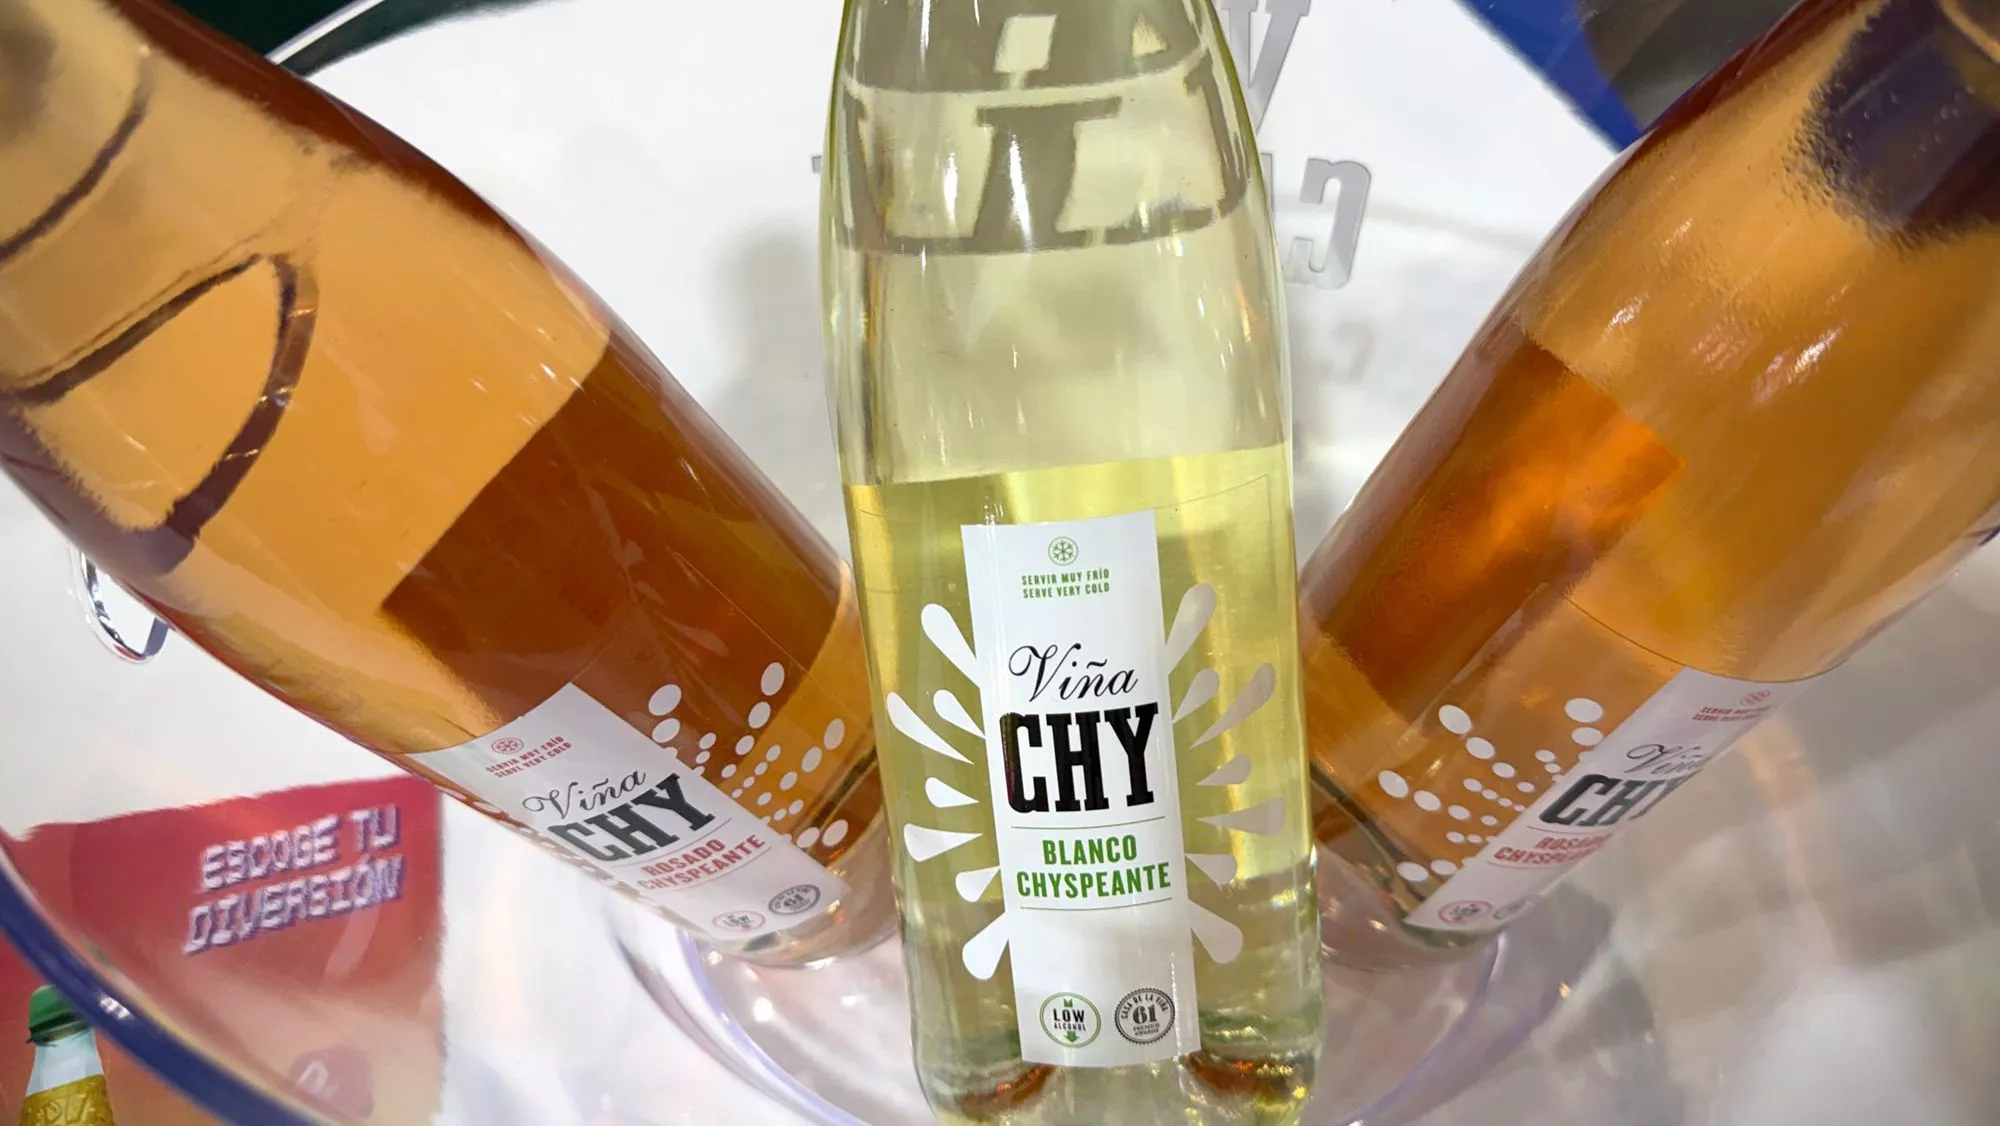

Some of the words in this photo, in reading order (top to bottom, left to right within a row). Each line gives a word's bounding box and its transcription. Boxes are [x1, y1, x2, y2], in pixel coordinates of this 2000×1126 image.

[1022, 574, 1057, 586] SERVIR
[1061, 571, 1082, 583] MUY
[1087, 567, 1110, 581] FRÍO
[1023, 587, 1053, 599] SERVE
[1056, 585, 1081, 597] VERY
[1085, 582, 1110, 594] COLD
[1008, 643, 1138, 702] Viña
[999, 702, 1158, 813] CHY
[523, 770, 646, 819] Viña
[548, 772, 716, 861] CHY
[202, 813, 341, 892] ESCOGE
[350, 803, 402, 852] TU
[637, 834, 766, 890] CHYSPEANTE
[641, 839, 725, 876] ROSADO
[1042, 834, 1137, 865] BLANCO
[1016, 862, 1171, 898] CHYSPEANTE
[1053, 1008, 1085, 1023] LOW
[1054, 1022, 1087, 1032] ALCOHOL
[1132, 1005, 1157, 1024] 61
